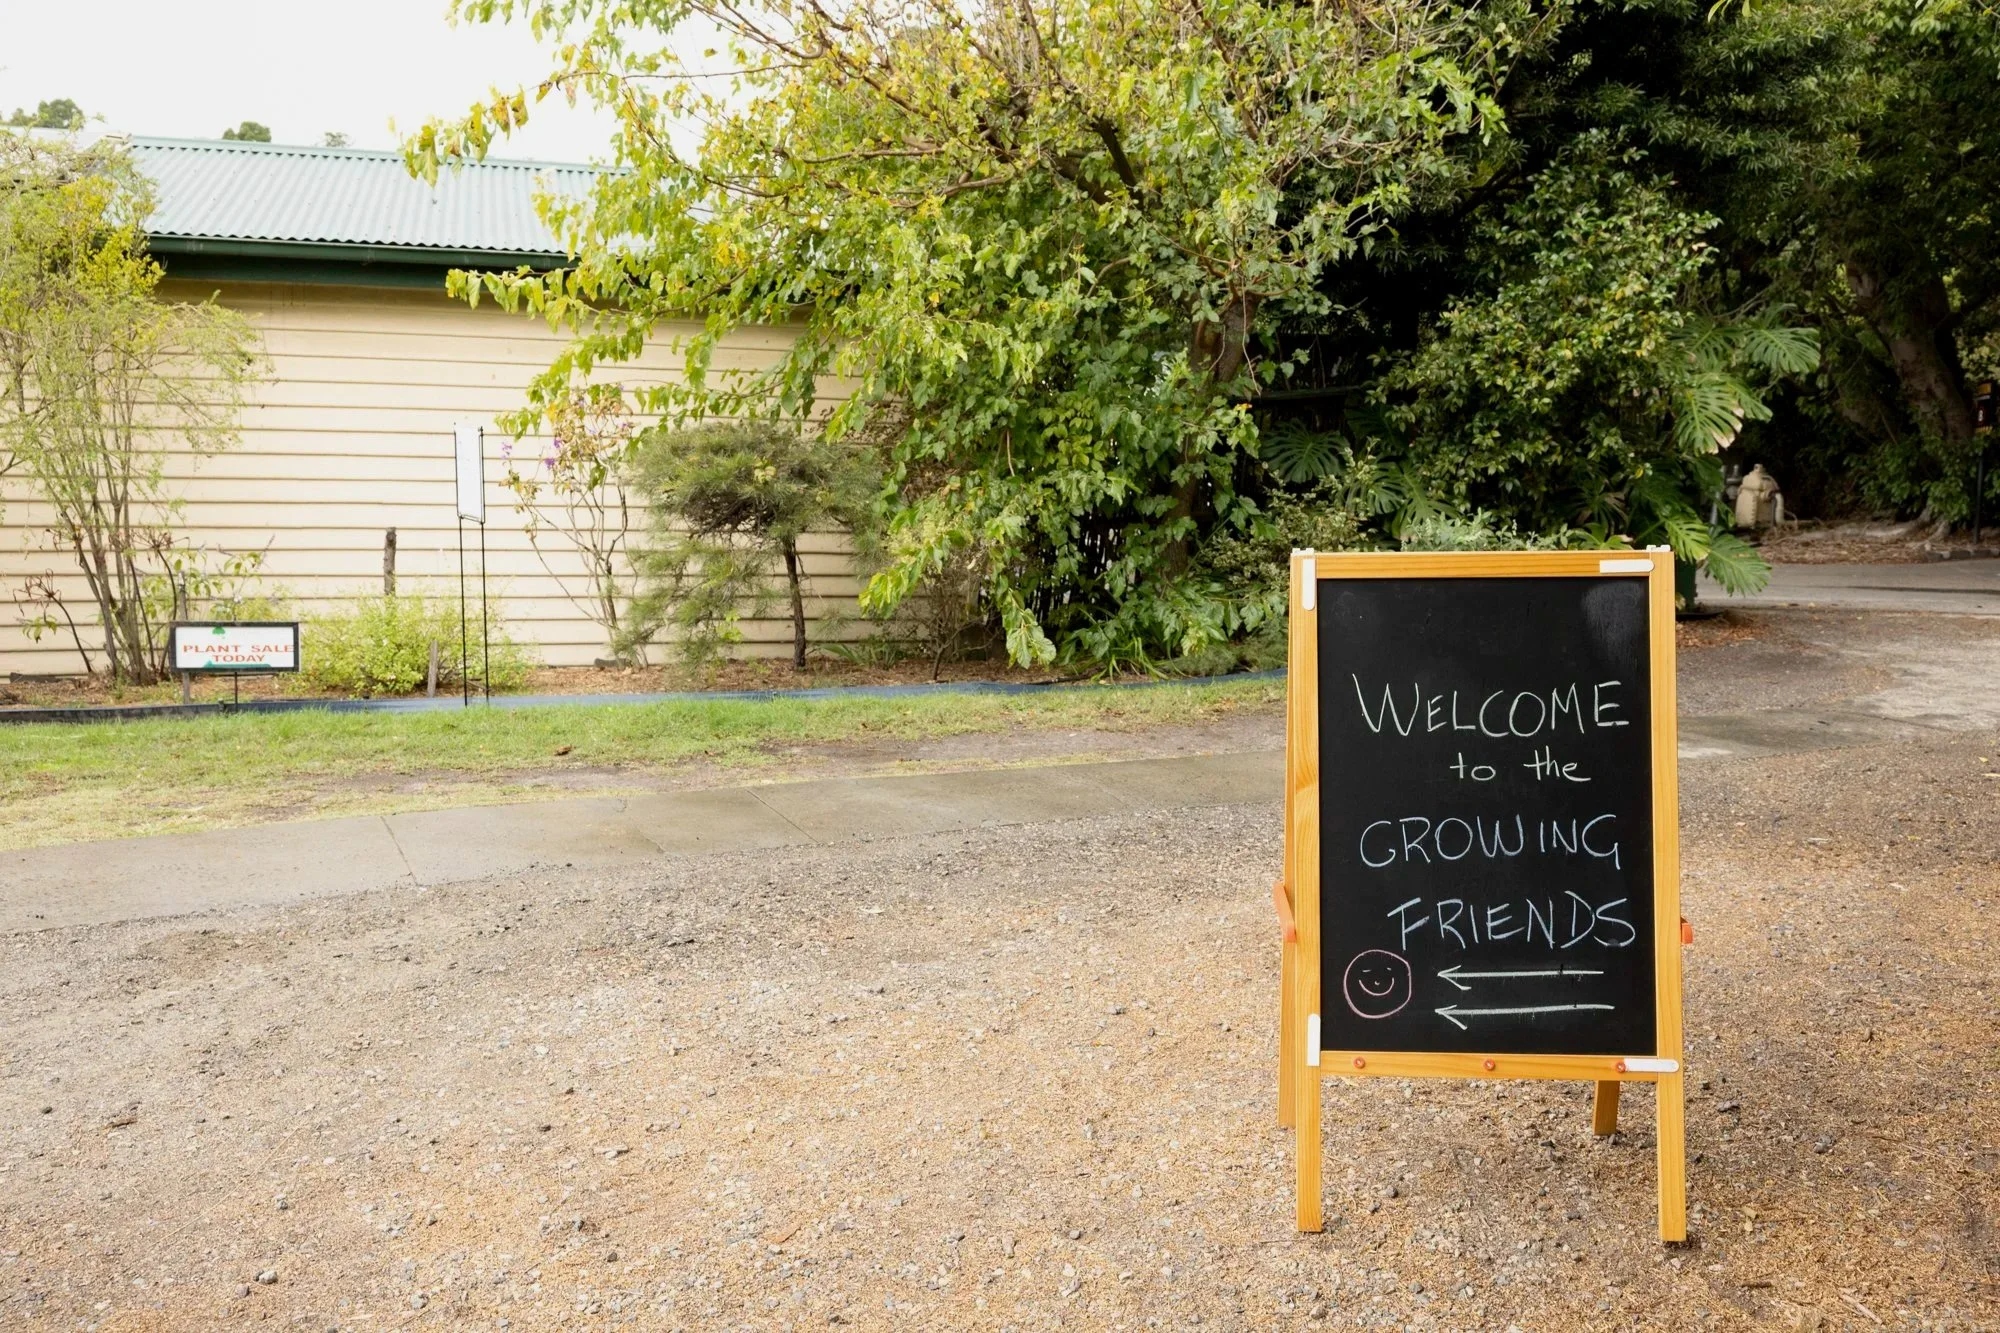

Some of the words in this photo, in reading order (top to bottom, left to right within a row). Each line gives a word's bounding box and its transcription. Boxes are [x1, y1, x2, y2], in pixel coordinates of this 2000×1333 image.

[183, 645, 241, 653] PLANT
[251, 645, 294, 653] SALE
[212, 654, 265, 662] TODAY
[1352, 673, 1630, 738] WELCOME
[1450, 752, 1497, 782] to
[1523, 745, 1592, 782] the
[1359, 813, 1622, 871] GROWING
[1387, 890, 1636, 951] FRIENDS
